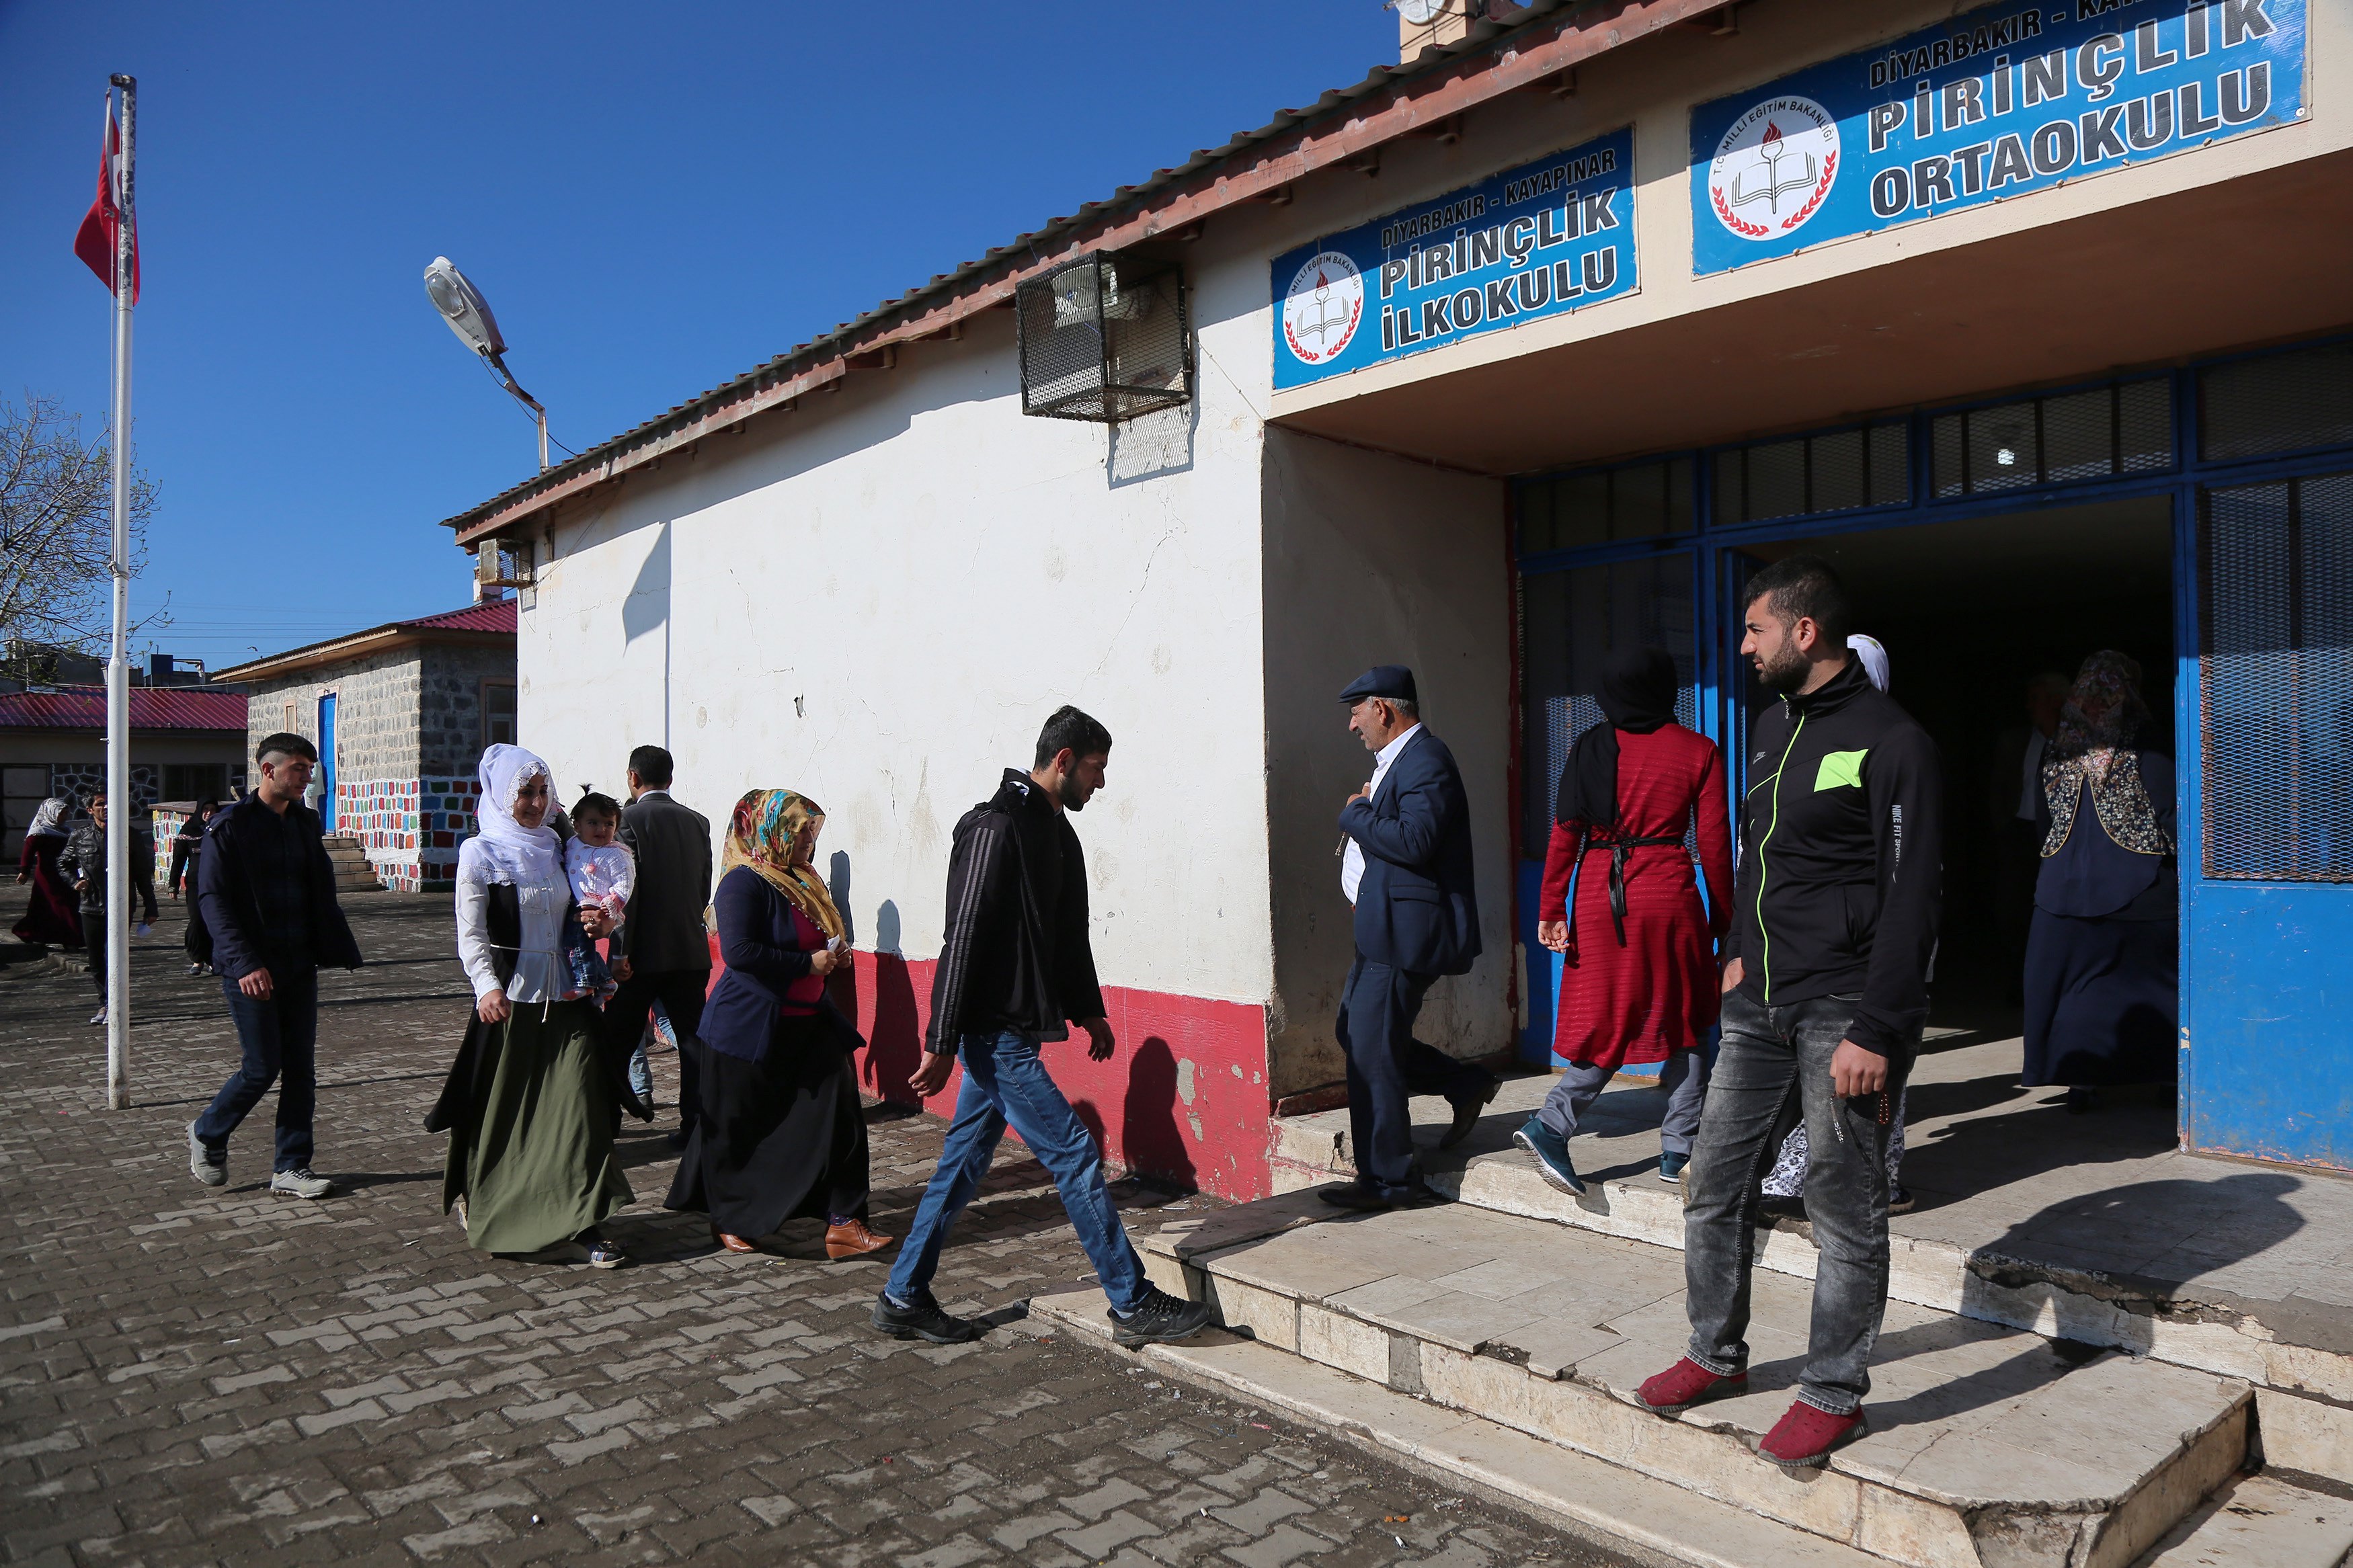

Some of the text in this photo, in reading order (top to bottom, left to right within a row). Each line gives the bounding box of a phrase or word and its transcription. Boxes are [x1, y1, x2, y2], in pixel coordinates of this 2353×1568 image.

[1869, 0, 2278, 154] PİRİNÇLİK
[1870, 9, 2042, 89] DİYARBAKIR
[1749, 100, 1787, 123] EĞİTİM
[1789, 101, 1833, 142] BAKANLIĞI
[1870, 60, 2271, 218] ORTAOKULU
[1380, 187, 1620, 300] PİRİNÇLİK
[1382, 194, 1485, 249] DİYARBAKIR
[1505, 148, 1616, 206] KAYAPINAR
[1307, 254, 1332, 272] EĞİTİM
[1332, 255, 1361, 290] BAKANLIĞI
[1382, 245, 1618, 352] İLKOKULU
[1892, 804, 1902, 823] NIKE
[1893, 825, 1902, 837] FIT
